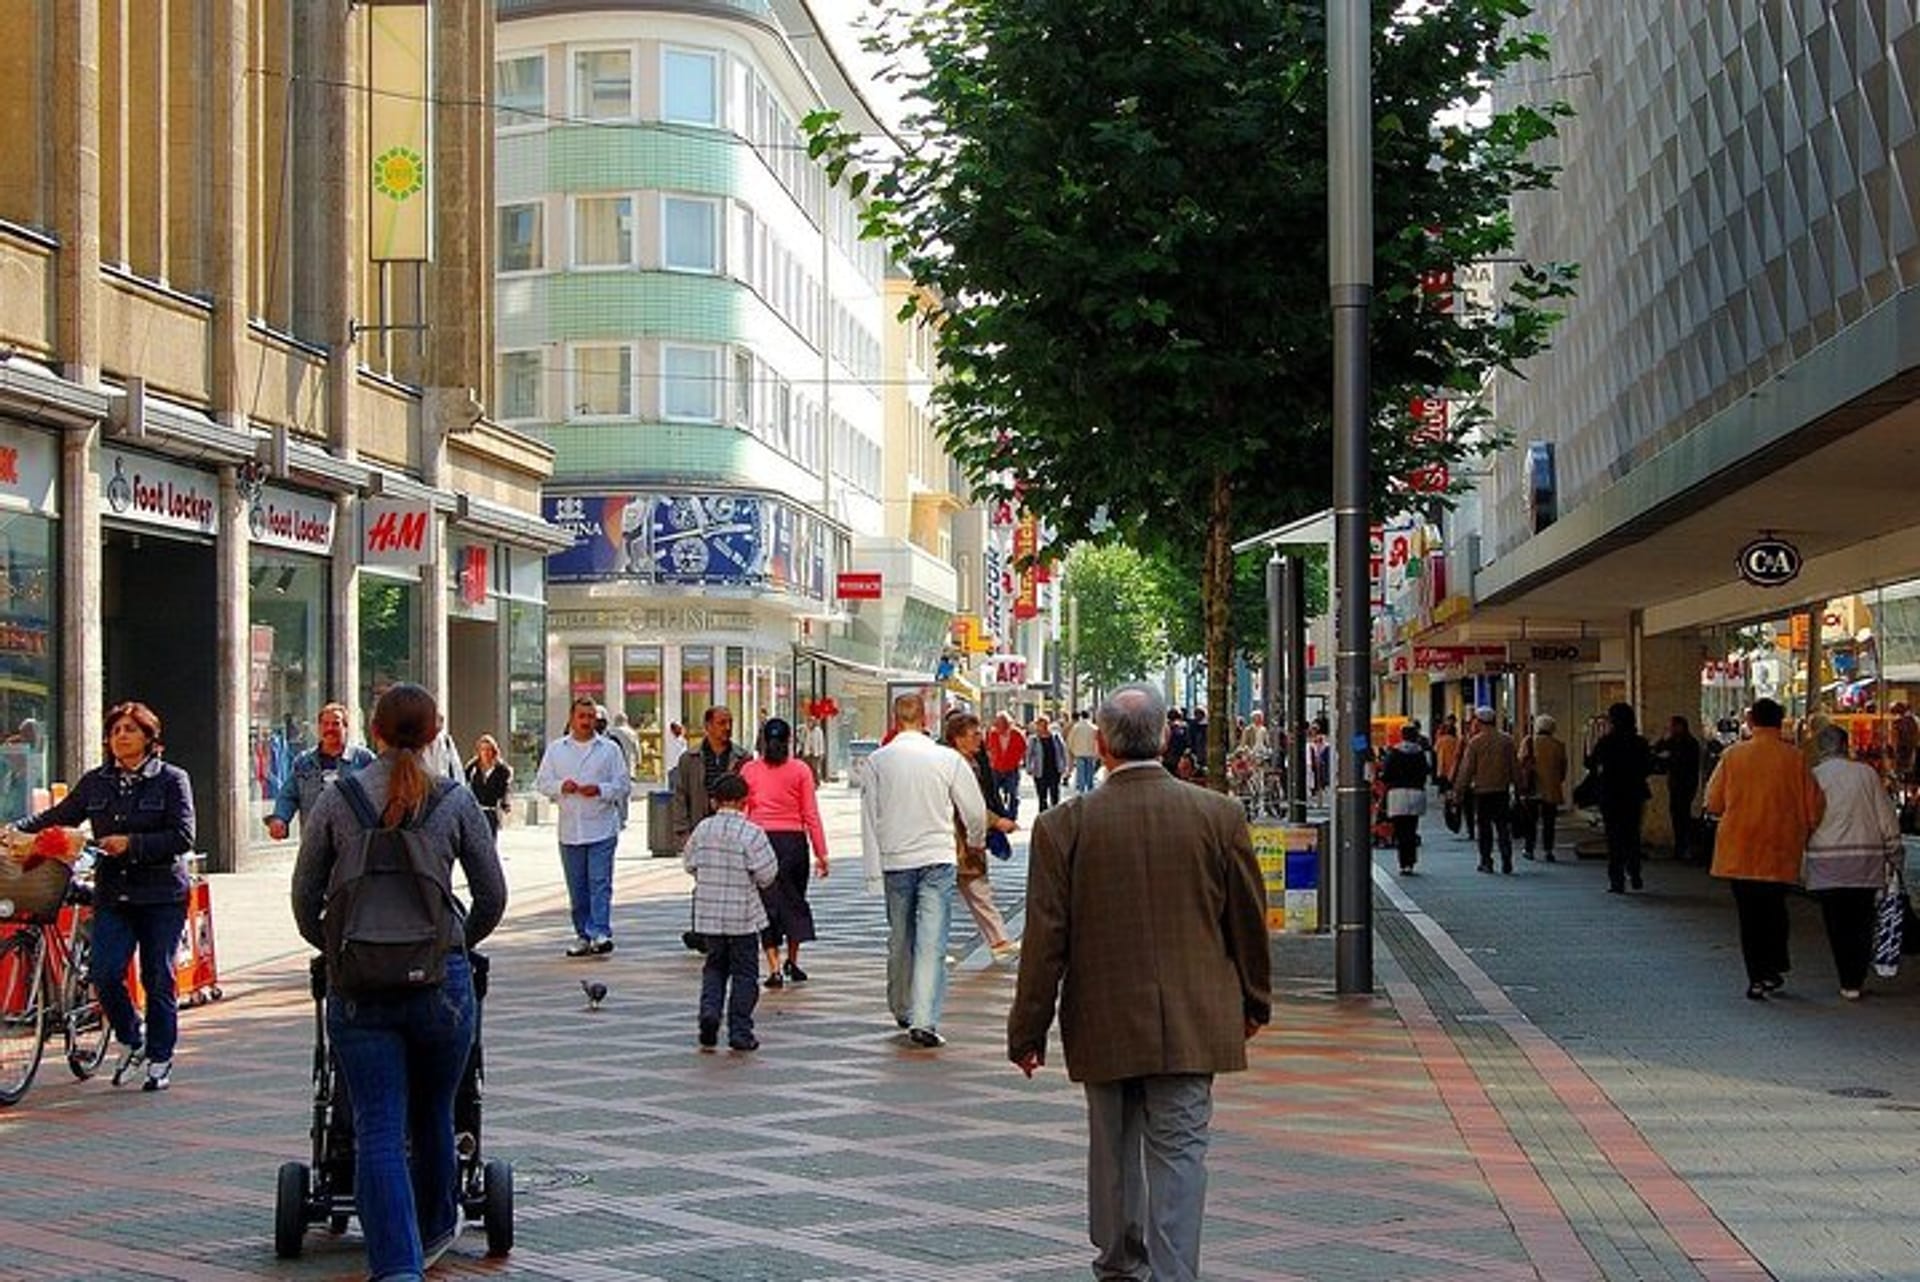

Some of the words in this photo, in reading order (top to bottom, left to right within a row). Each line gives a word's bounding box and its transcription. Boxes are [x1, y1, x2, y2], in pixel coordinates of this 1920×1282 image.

[133, 474, 163, 516] Foot
[167, 482, 213, 525] Locker
[268, 505, 292, 539] Foot
[294, 508, 329, 544] Locker
[368, 511, 427, 552] H&M
[1749, 549, 1791, 573] C&A
[1532, 646, 1579, 662] RENO
